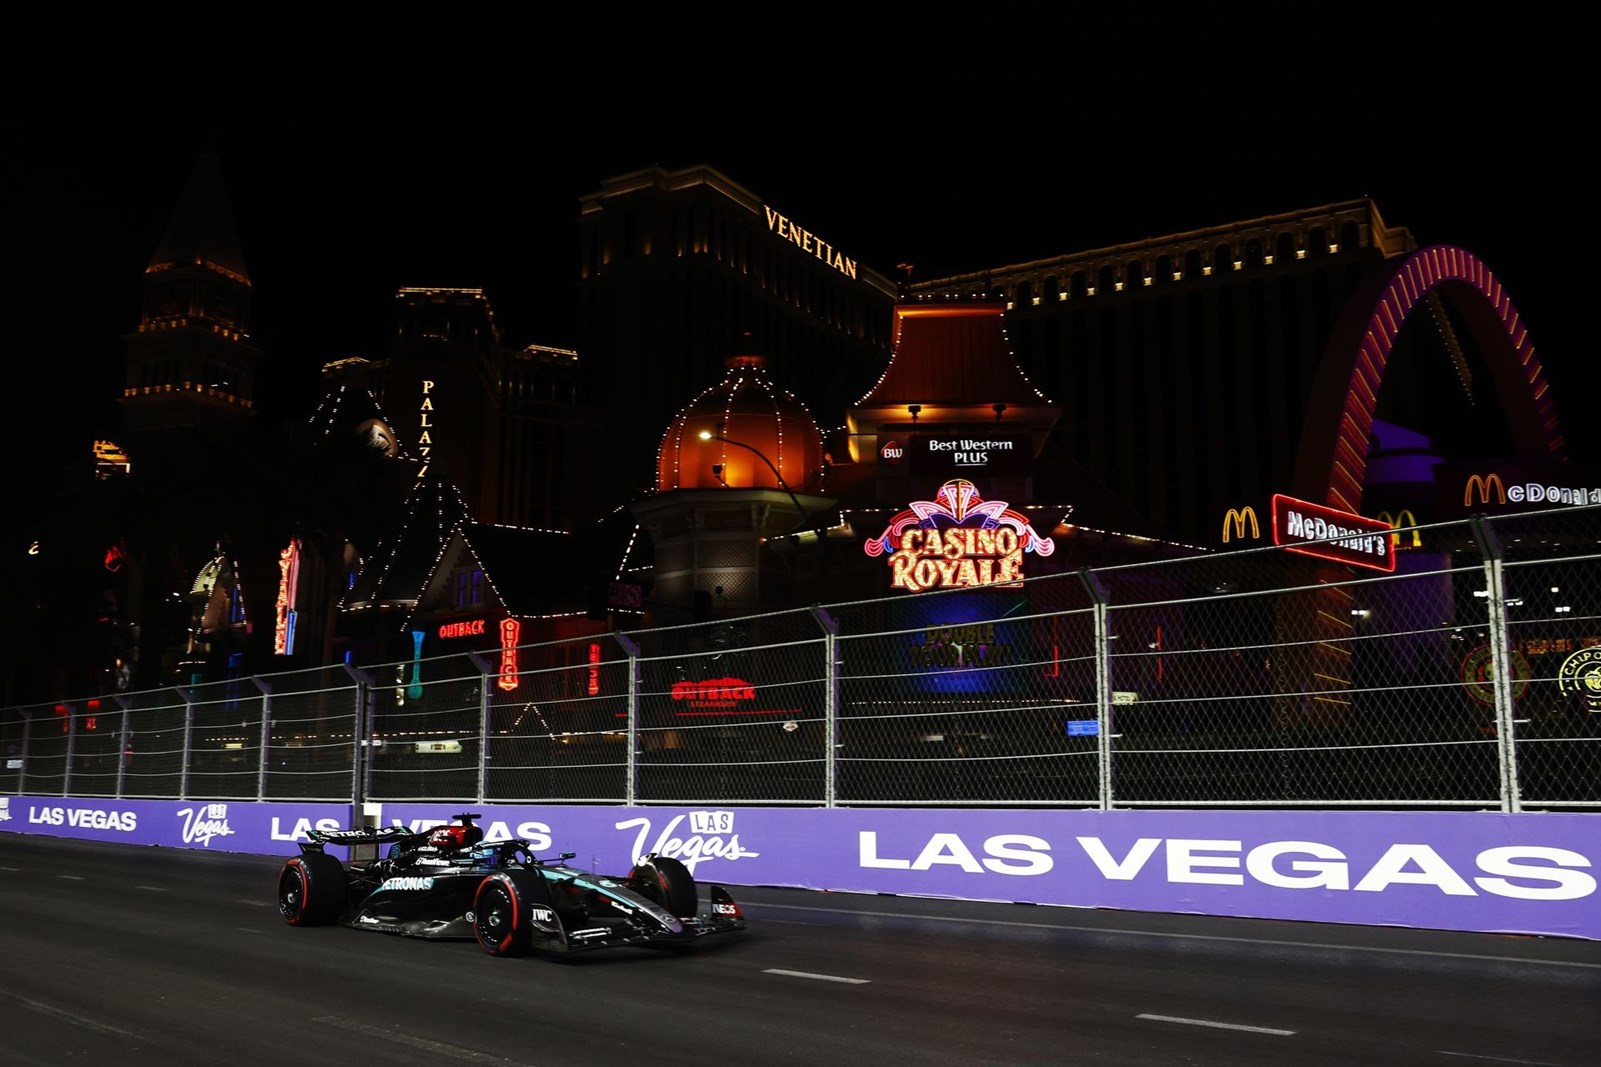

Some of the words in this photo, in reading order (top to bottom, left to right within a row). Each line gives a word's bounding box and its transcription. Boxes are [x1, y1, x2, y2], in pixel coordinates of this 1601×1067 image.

[763, 204, 858, 280] VENETIAN
[883, 448, 903, 459] BW
[929, 439, 958, 451] Best
[960, 440, 1013, 450] Western
[954, 452, 988, 463] PLUS
[900, 527, 1019, 559] CASINO
[887, 549, 1025, 592] ROYALE
[439, 620, 485, 638] OUTBACK
[672, 687, 756, 701] OUTBACK
[29, 806, 65, 826] LAS
[66, 808, 138, 832] VEGAS
[176, 806, 235, 847] Vegas
[694, 814, 729, 831] LAS
[321, 828, 395, 838] PETROAS
[615, 814, 760, 878] Vegas
[858, 831, 1054, 876] LAS
[1075, 836, 1598, 900] VEGAS
[532, 908, 553, 922] IWC
